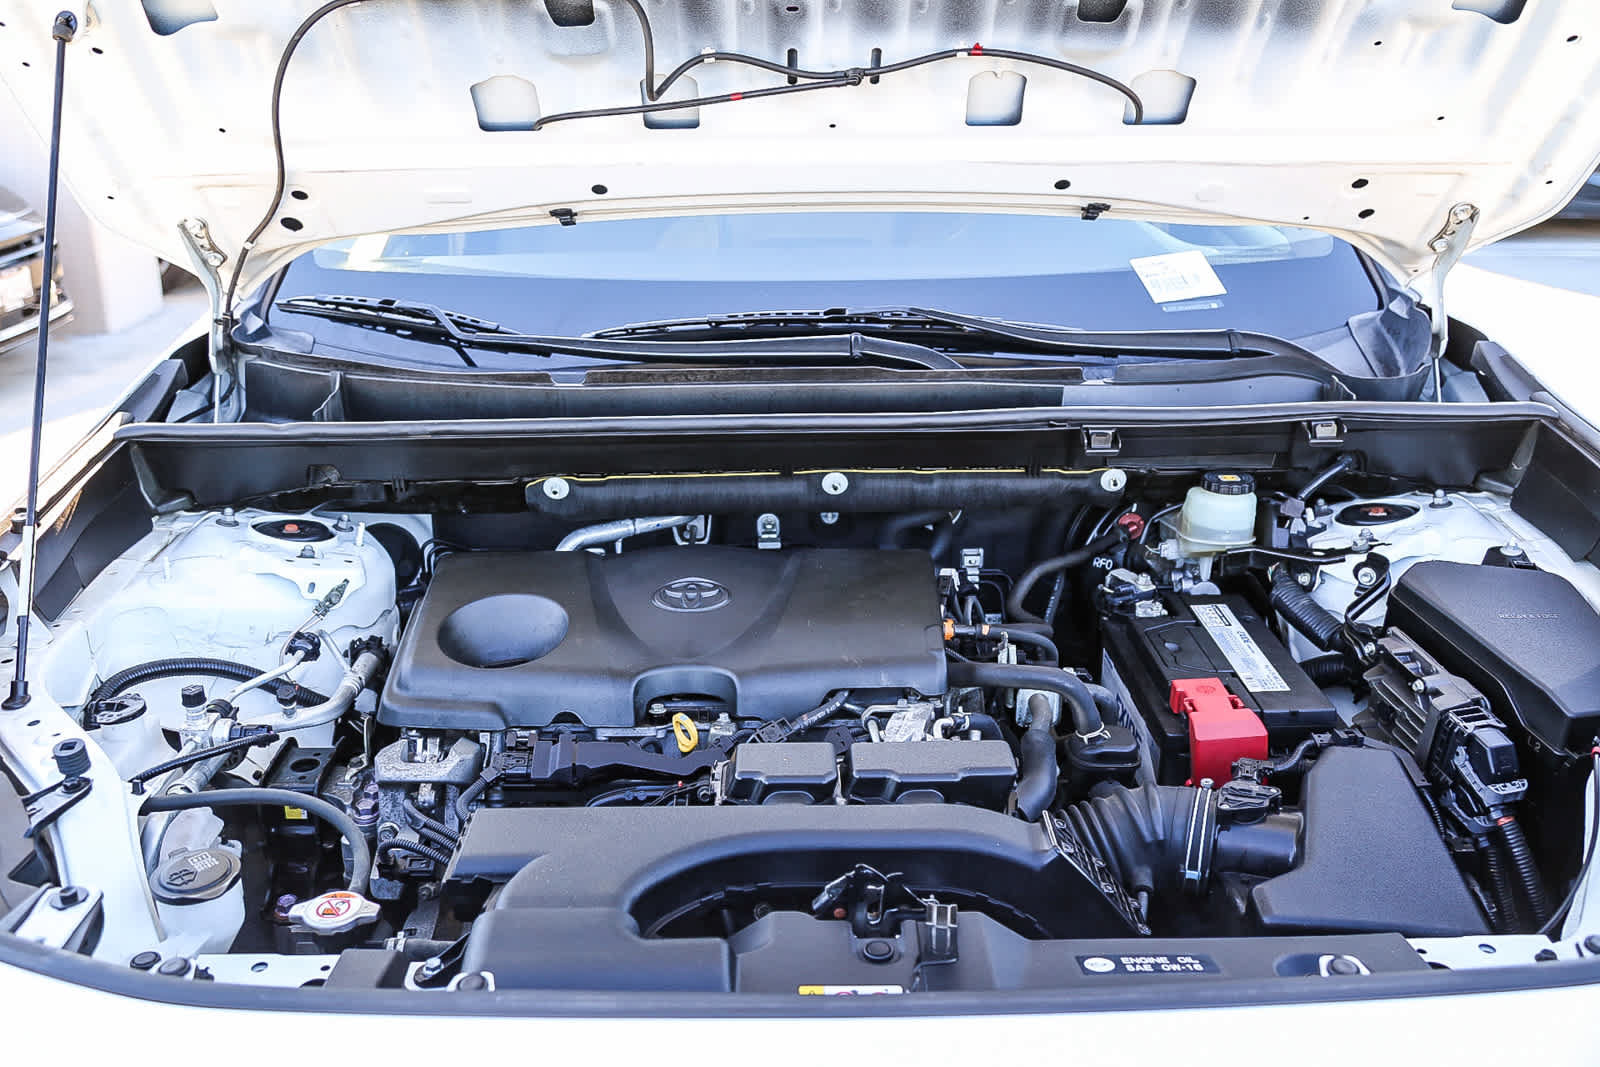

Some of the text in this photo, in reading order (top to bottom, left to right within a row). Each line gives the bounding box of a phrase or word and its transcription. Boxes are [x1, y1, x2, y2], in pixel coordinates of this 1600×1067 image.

[1120, 956, 1170, 965] ENGINE
[1176, 956, 1200, 964] OIL
[1125, 964, 1154, 972] SAE
